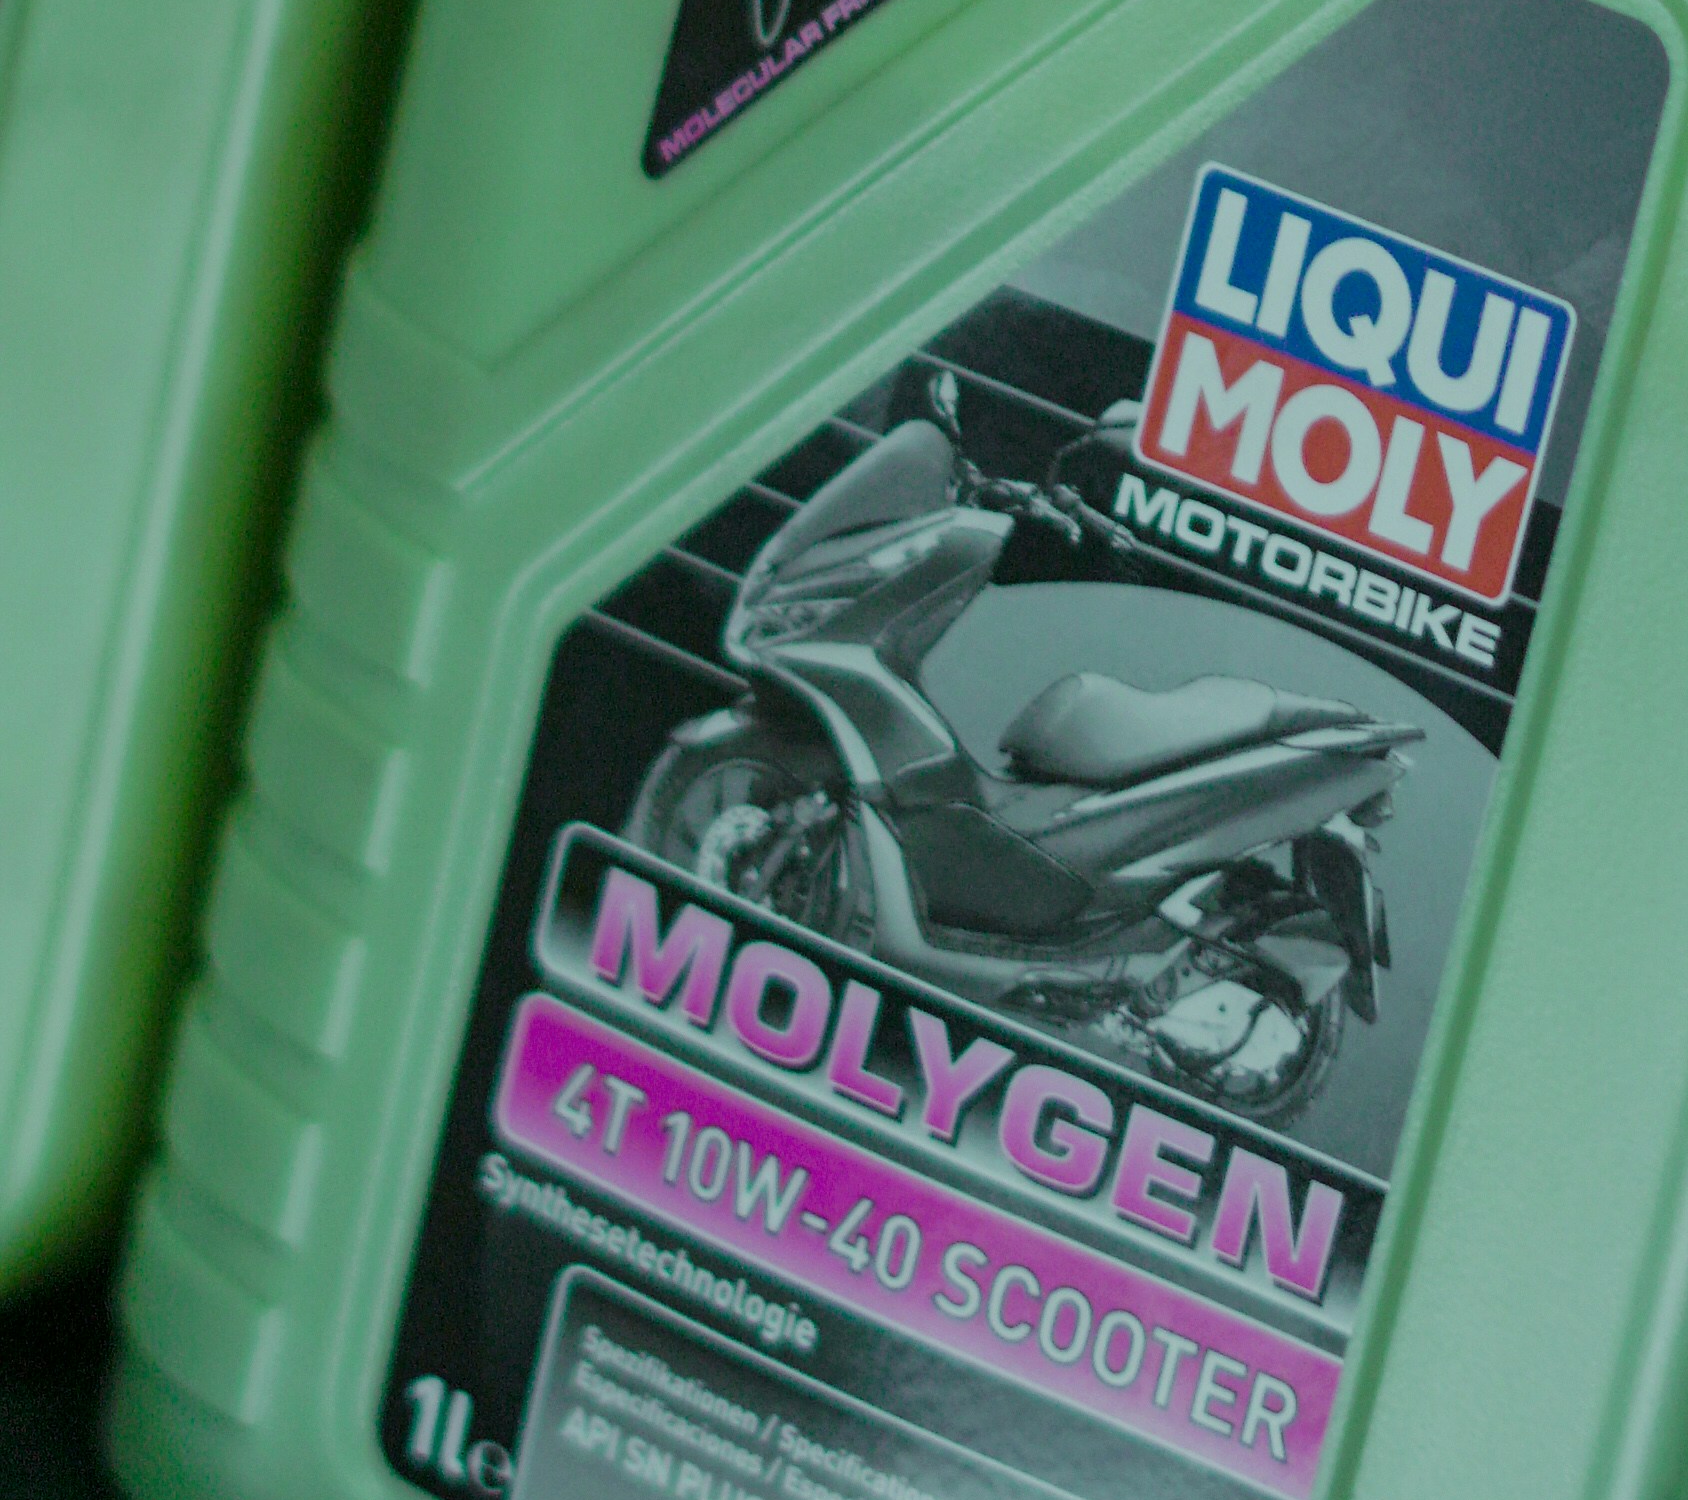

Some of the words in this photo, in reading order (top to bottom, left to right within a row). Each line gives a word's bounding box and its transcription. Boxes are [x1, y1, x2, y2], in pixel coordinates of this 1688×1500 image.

[659, 17, 823, 161] MOLECULAR
[1194, 187, 1552, 435] LIQUI
[1158, 330, 1528, 573] MOLY
[1113, 473, 1501, 667] MOTORBIKE
[590, 866, 1344, 1299] MOLYGEN
[479, 1154, 819, 1350] Synthesetechnologie
[553, 1063, 645, 1154] 4T
[662, 1109, 921, 1290] 10W-40
[934, 1241, 1298, 1462] SCOOTER
[563, 1409, 621, 1456] API
[623, 1443, 673, 1484] SN
